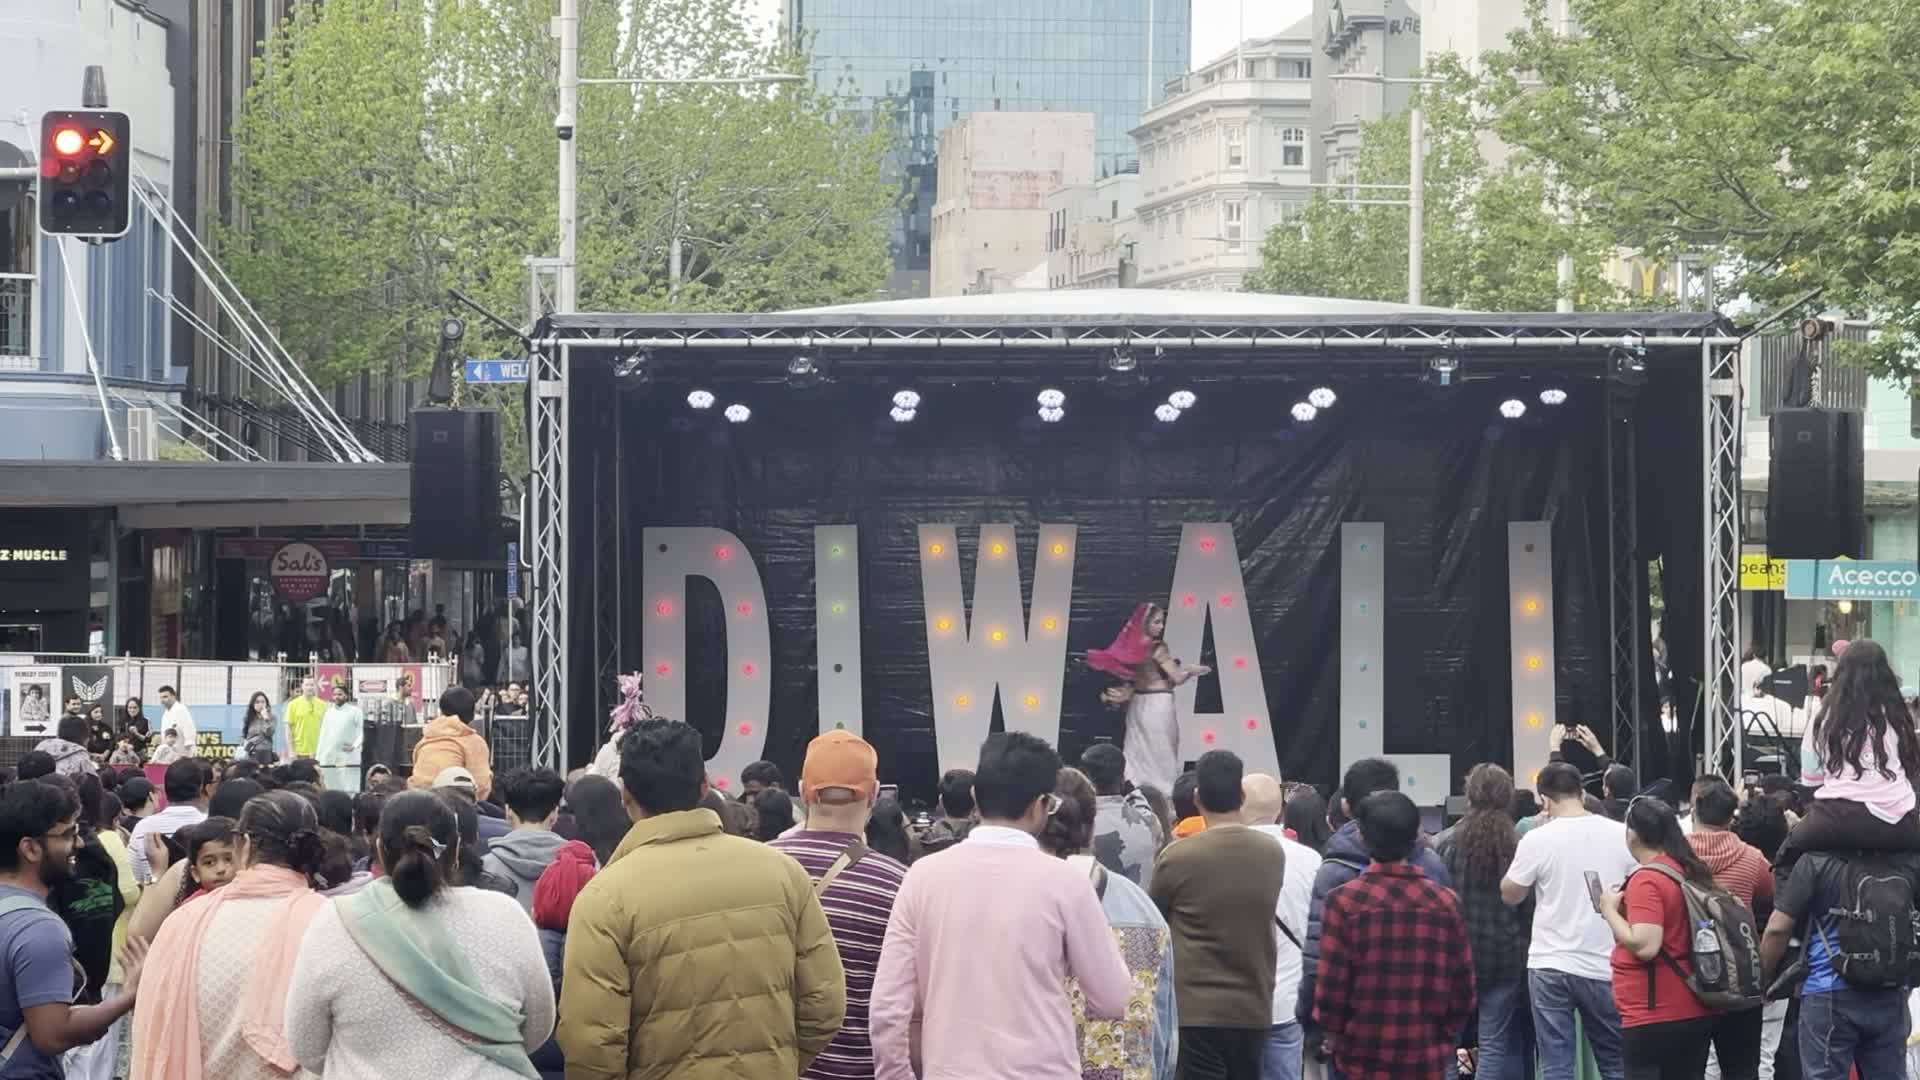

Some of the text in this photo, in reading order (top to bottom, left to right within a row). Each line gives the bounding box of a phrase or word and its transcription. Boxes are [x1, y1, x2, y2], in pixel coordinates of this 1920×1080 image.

[277, 551, 322, 571] Sal's
[1828, 564, 1917, 586] Acecco
[1832, 588, 1912, 597] SUPERMARKET
[642, 521, 1557, 806] DIWALI
